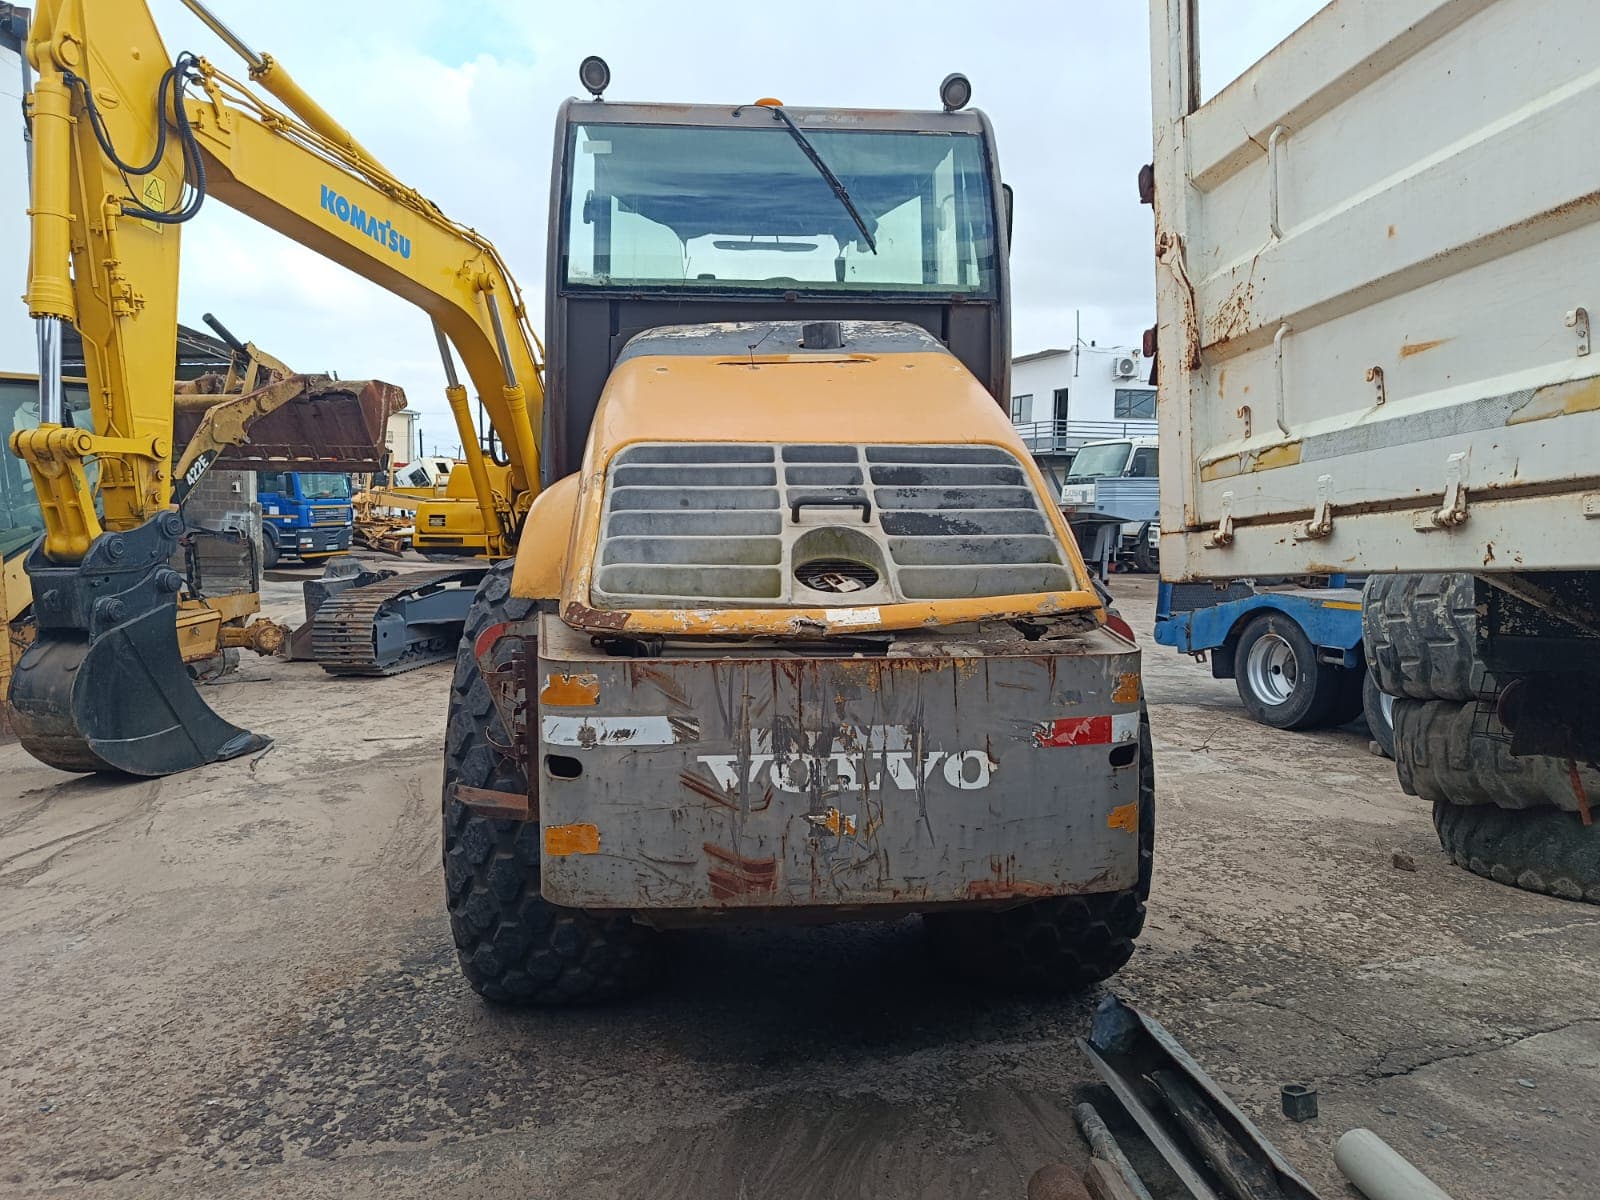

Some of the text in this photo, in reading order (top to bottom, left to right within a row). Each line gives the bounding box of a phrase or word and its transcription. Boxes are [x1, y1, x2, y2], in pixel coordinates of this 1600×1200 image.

[320, 184, 411, 259] KOMATSU
[186, 454, 210, 486] 422E
[697, 751, 990, 793] VOLVO
